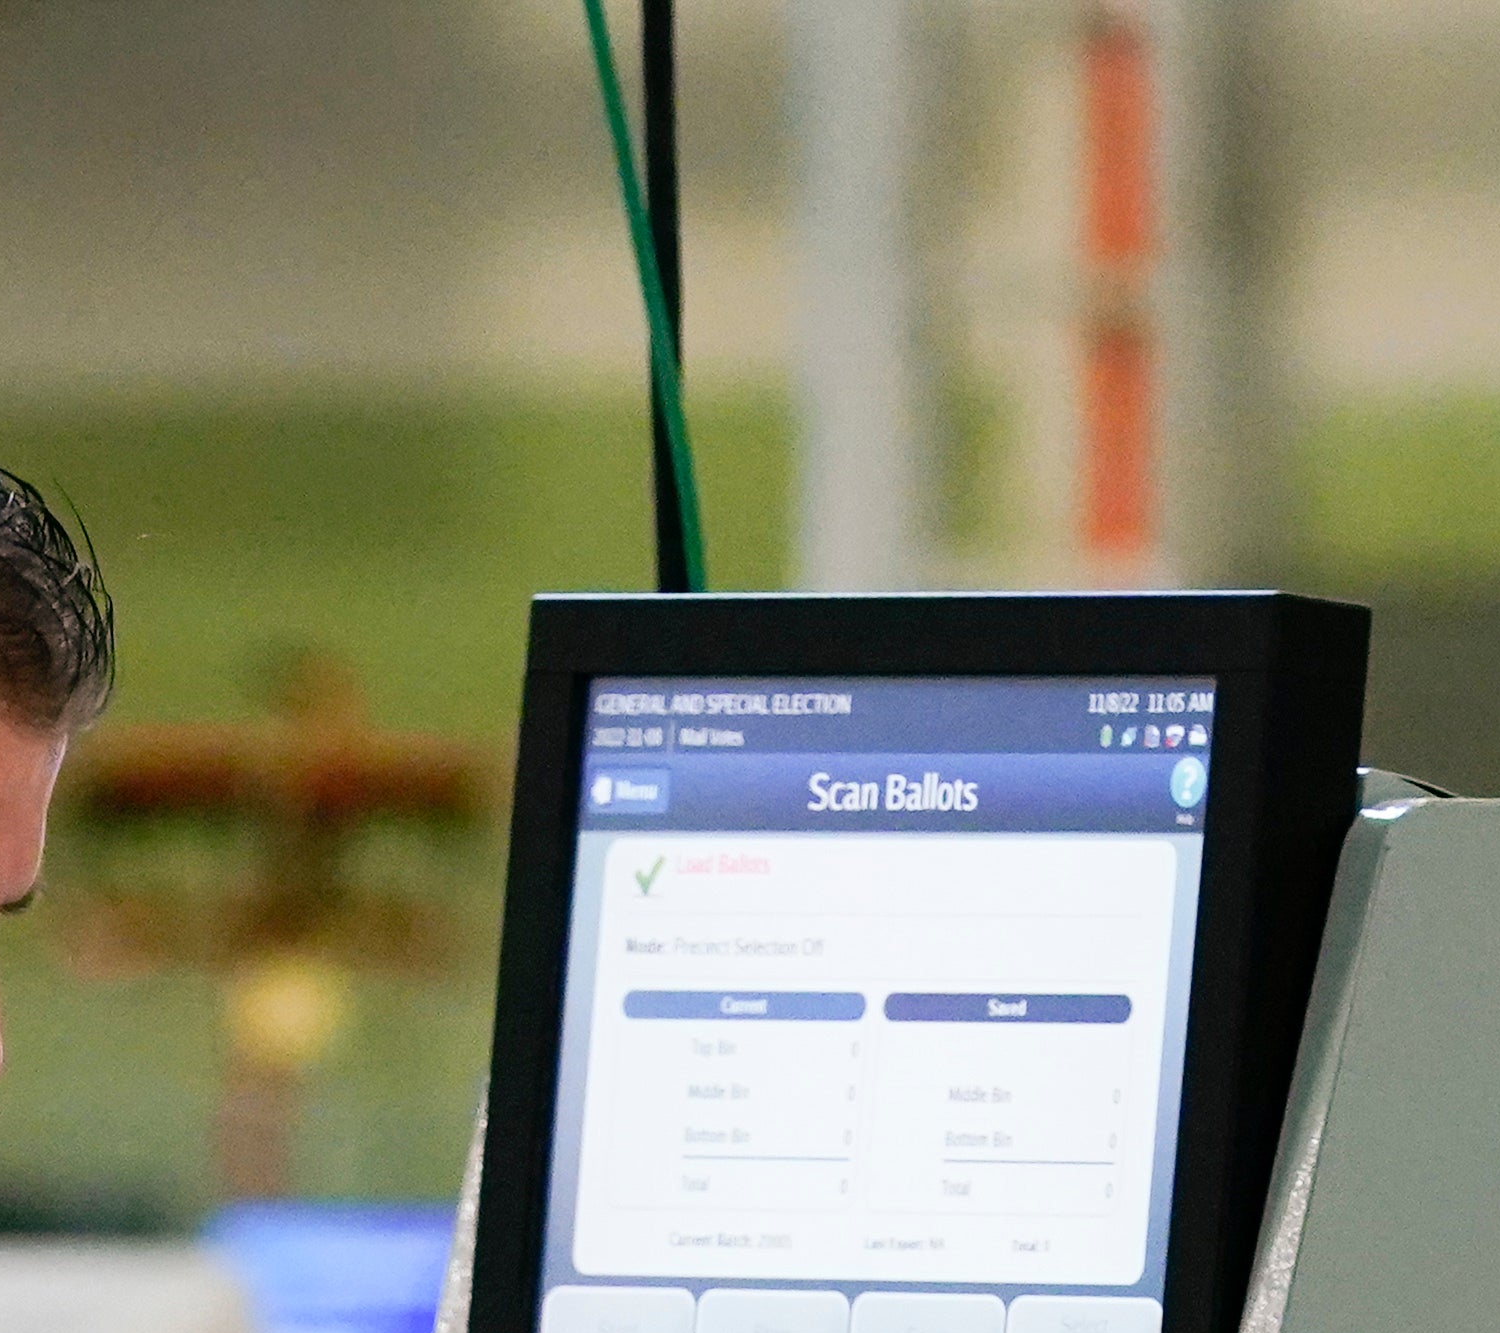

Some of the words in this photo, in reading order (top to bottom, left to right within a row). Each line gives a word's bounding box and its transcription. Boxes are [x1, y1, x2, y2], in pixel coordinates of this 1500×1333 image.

[595, 693, 667, 715] GENERAL
[670, 693, 704, 715] AND
[706, 693, 769, 715] SPECIAL
[772, 693, 852, 715] ELECTION
[1188, 692, 1213, 714] AM
[807, 772, 879, 812] Scan
[885, 773, 978, 813] Ballots
[733, 938, 798, 957] Selection
[988, 998, 1027, 1017] Saved
